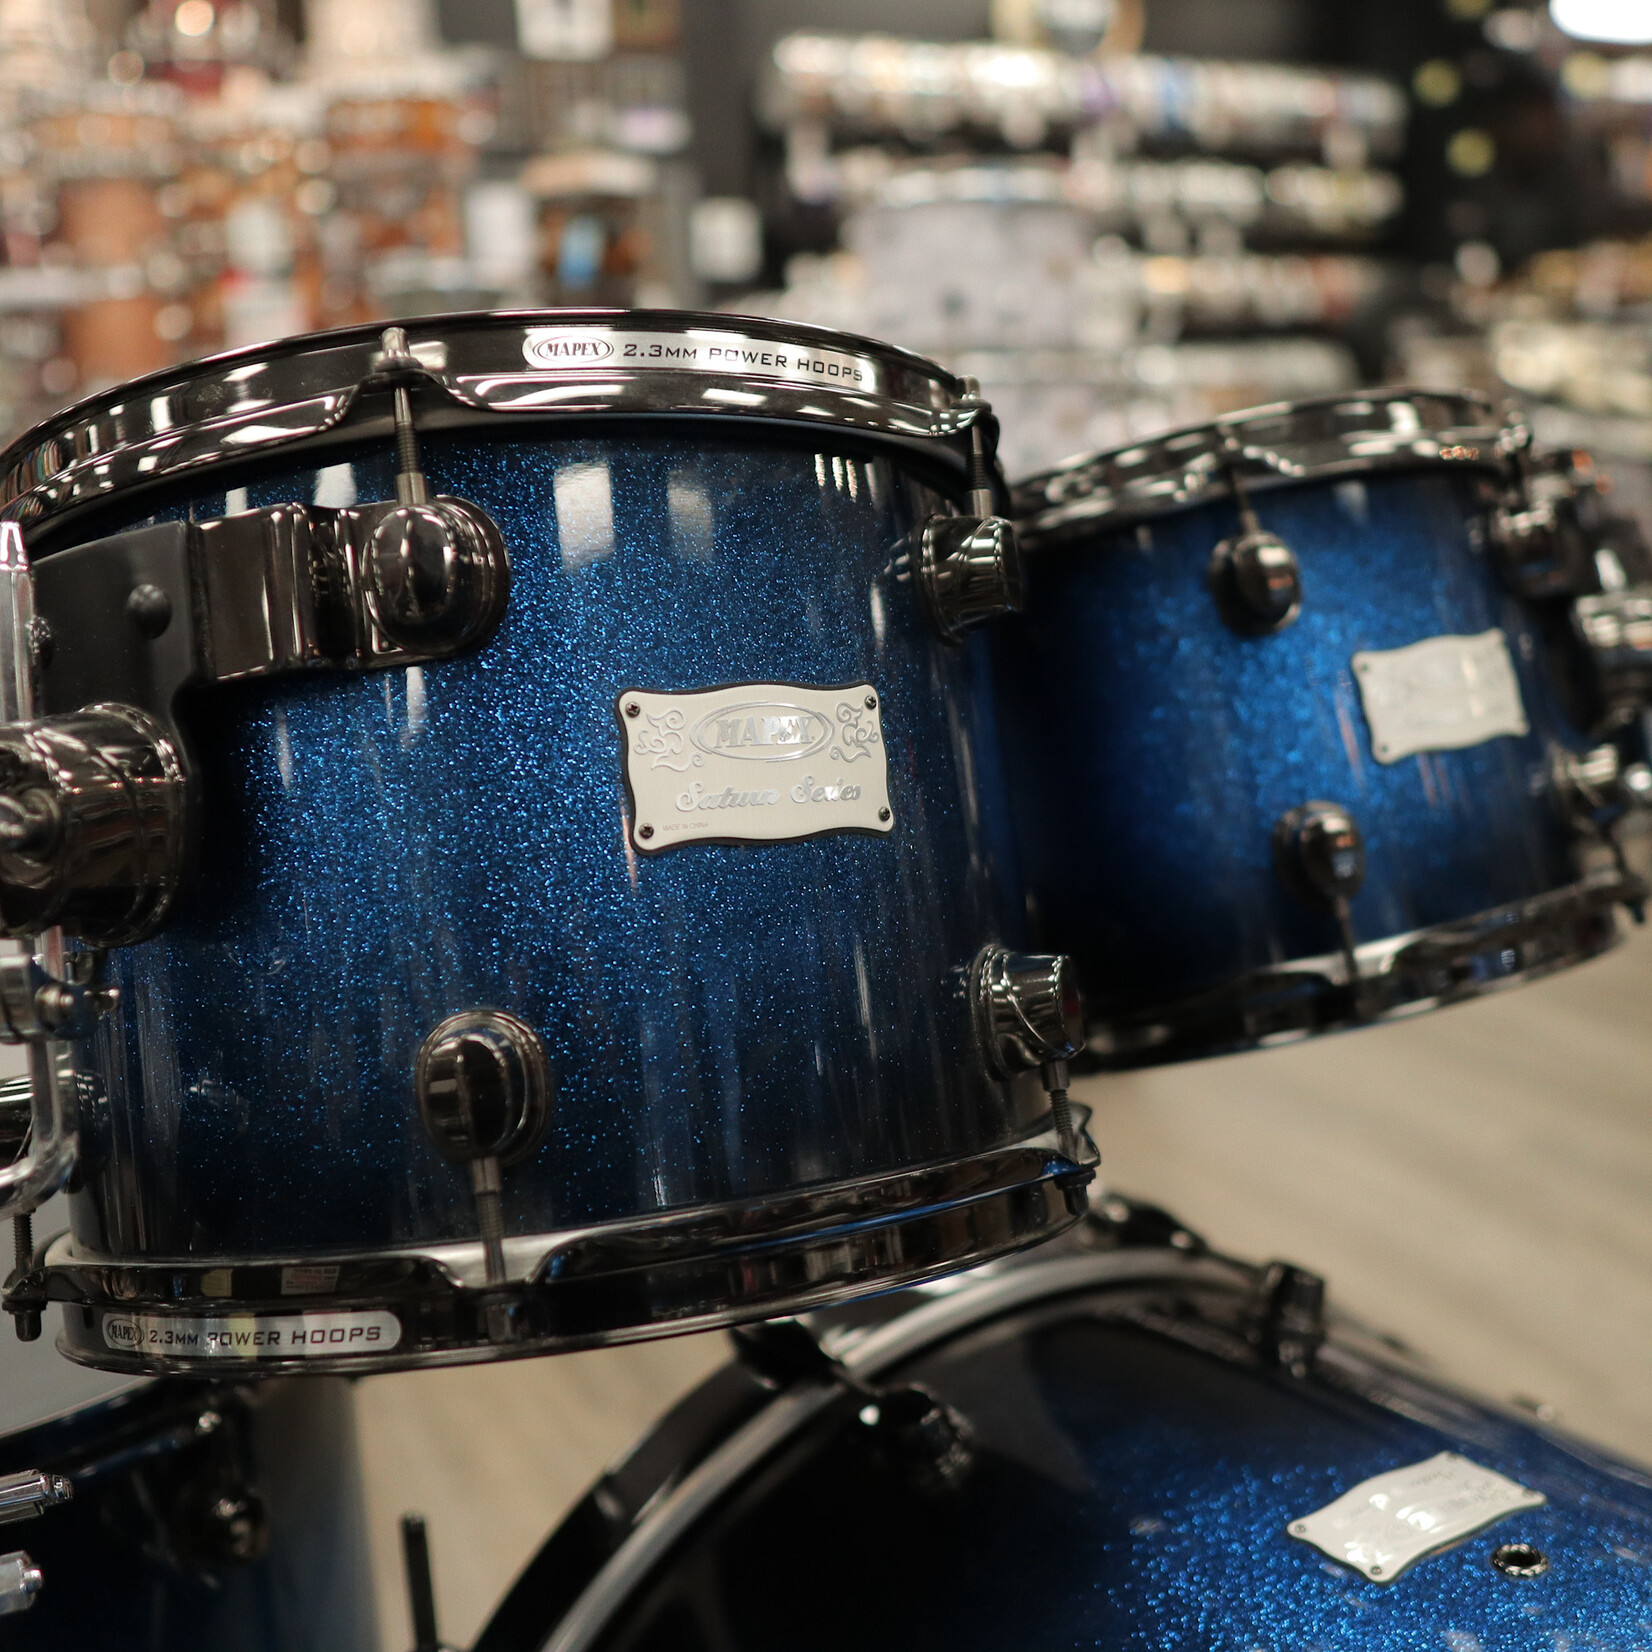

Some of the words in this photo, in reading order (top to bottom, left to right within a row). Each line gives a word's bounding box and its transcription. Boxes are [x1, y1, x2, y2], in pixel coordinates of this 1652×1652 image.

[545, 342, 603, 359] MAPEX
[622, 343, 698, 360] 2.3MM
[708, 347, 788, 368] POWER
[797, 357, 864, 382] HOOPS
[715, 715, 815, 749] MAPEX
[675, 781, 780, 812] Saturn
[790, 774, 862, 804] Series
[662, 823, 681, 832] MADE
[111, 1324, 141, 1342] MAPEX
[149, 1329, 199, 1346] 2.3MM
[207, 1330, 280, 1346] POWER
[292, 1325, 382, 1345] HOOPS
